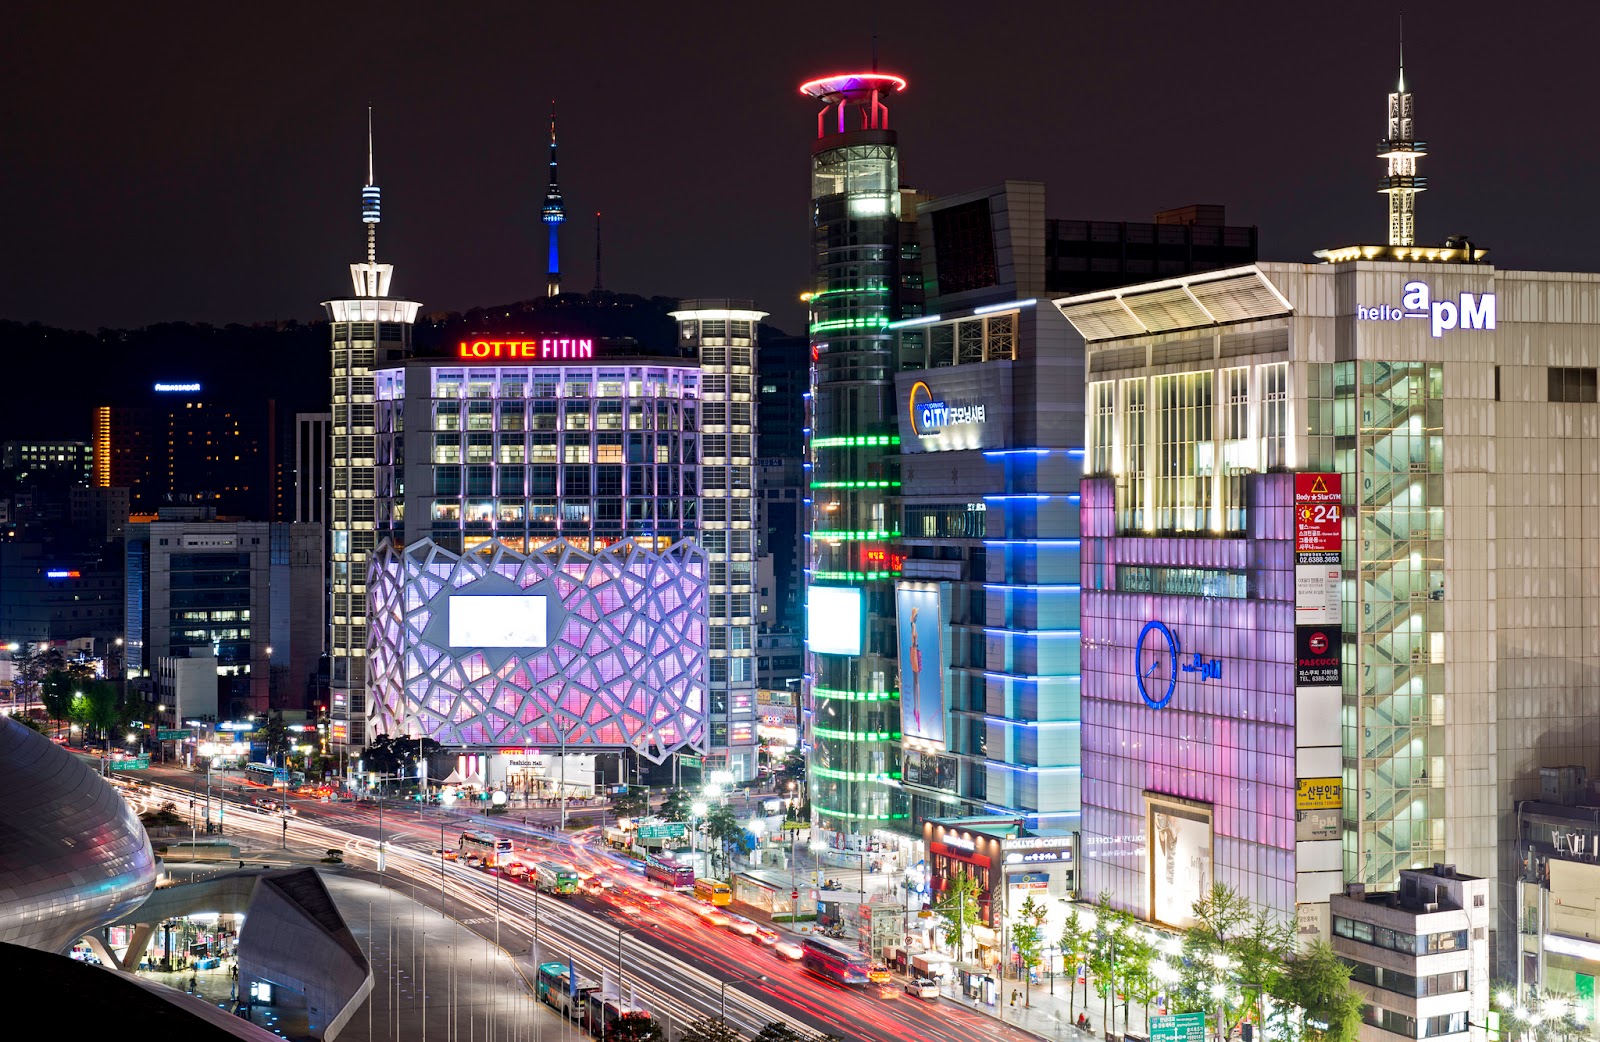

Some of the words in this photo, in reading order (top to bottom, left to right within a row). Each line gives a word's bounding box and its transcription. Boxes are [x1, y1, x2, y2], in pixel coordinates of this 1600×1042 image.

[1358, 304, 1402, 320] hello
[1402, 281, 1496, 337] apM
[461, 341, 535, 357] LOTTE
[542, 340, 591, 357] FITIN
[923, 408, 948, 427] CITY
[950, 405, 985, 425] 굿모닝시티
[1314, 505, 1340, 523] 24
[1364, 603, 1371, 615] 8
[1299, 658, 1339, 666] PASCUCCI
[1364, 665, 1371, 676] 7
[1308, 785, 1341, 800] 산부인과
[1365, 788, 1371, 799] 5
[1312, 815, 1337, 829] apM
[1006, 840, 1035, 849] HOLLYS
